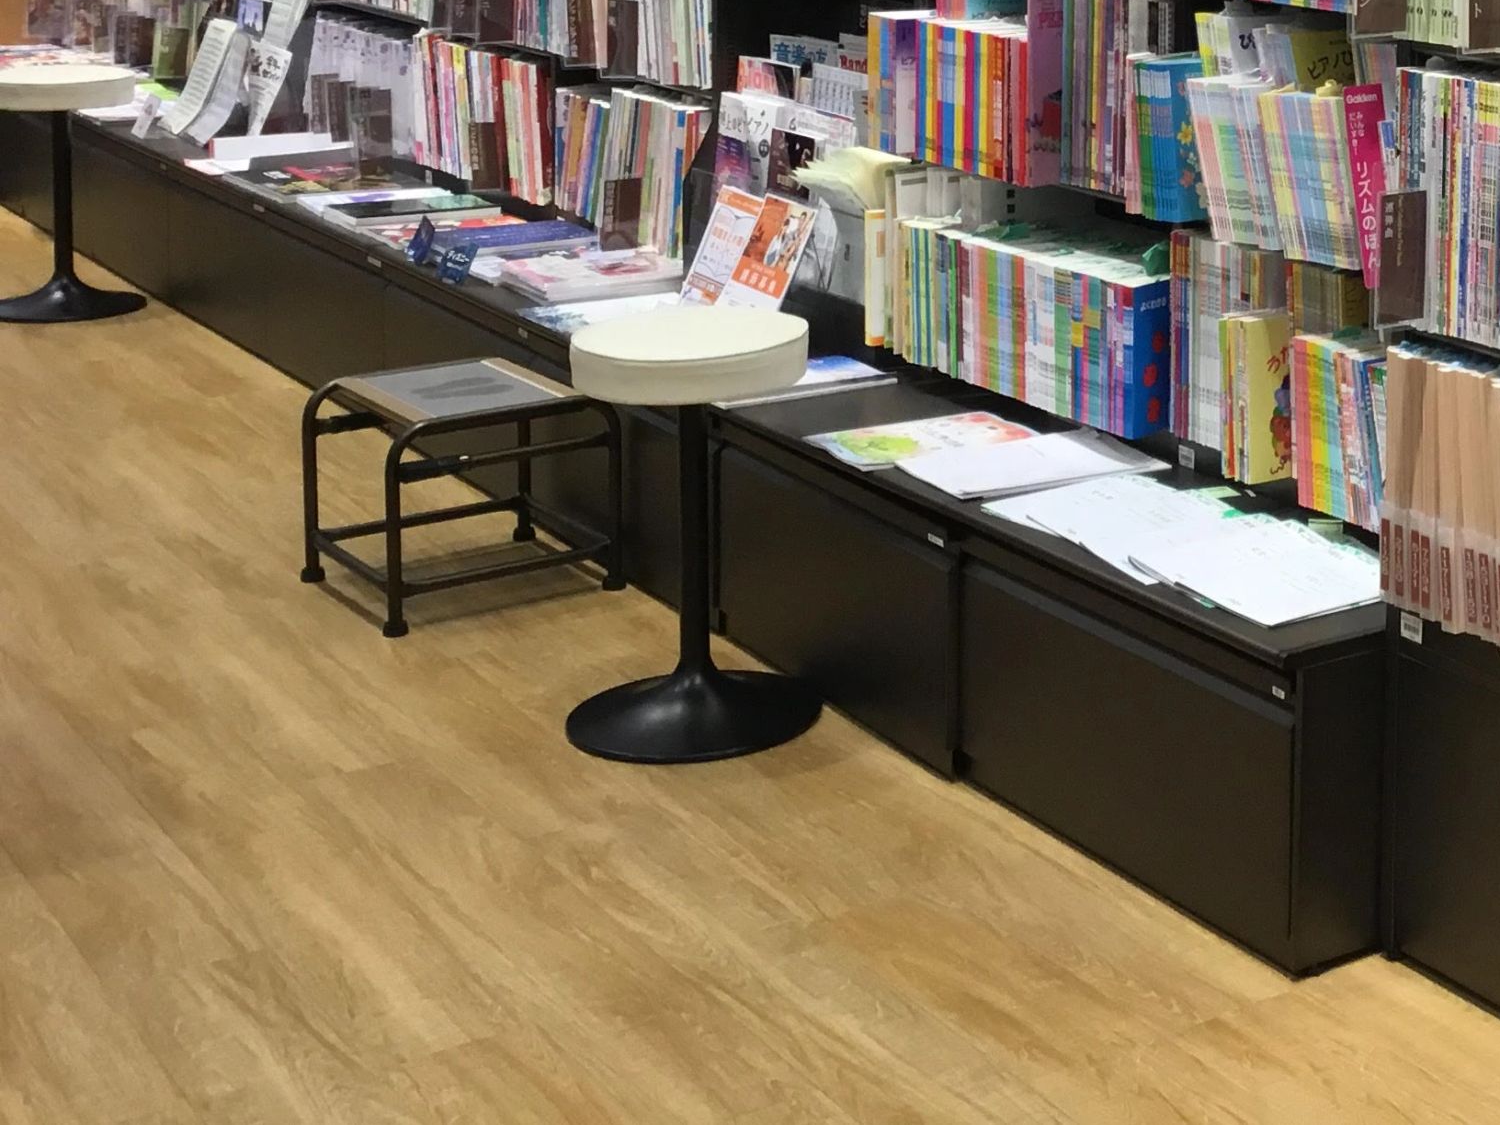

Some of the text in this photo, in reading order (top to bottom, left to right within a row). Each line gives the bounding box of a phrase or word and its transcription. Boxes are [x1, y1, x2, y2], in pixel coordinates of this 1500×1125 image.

[1346, 93, 1378, 105] Gakken
[1356, 162, 1381, 268] リズムのほん
